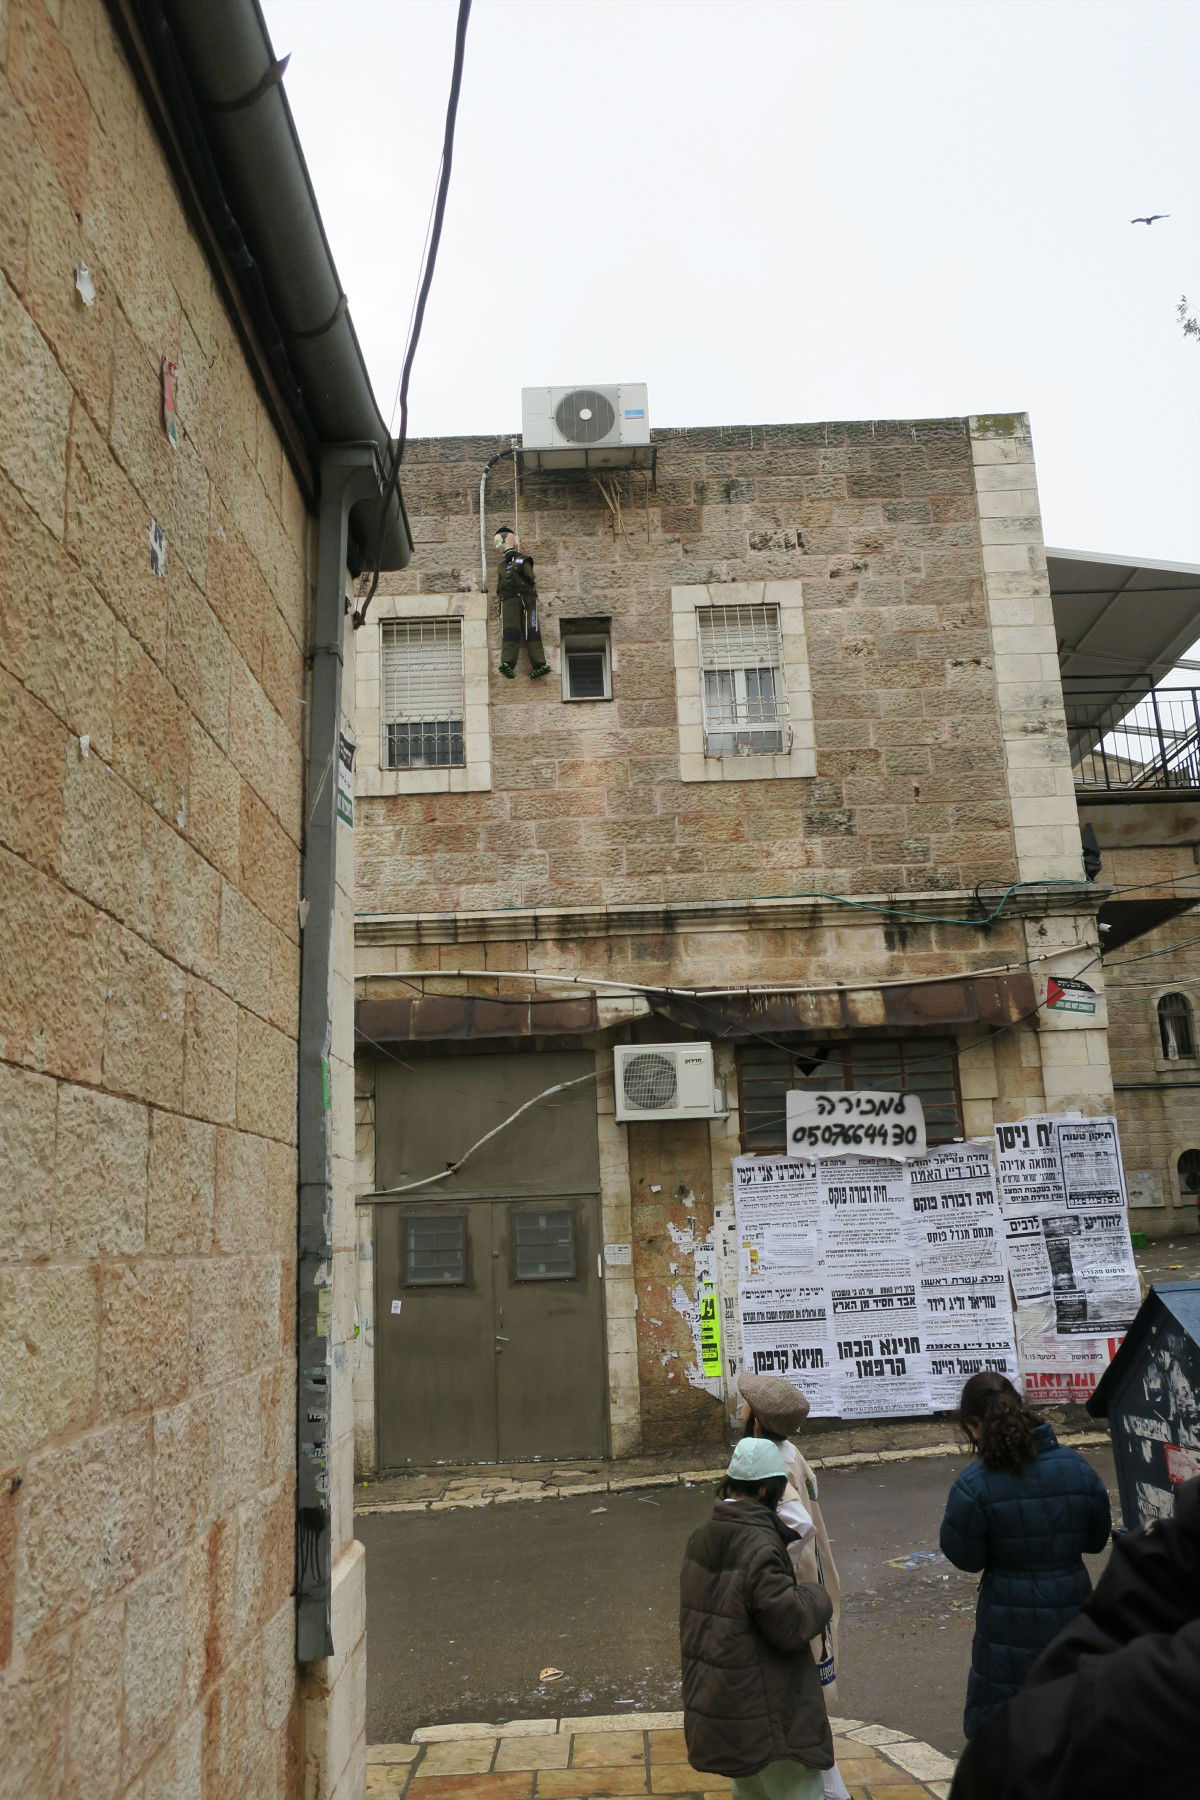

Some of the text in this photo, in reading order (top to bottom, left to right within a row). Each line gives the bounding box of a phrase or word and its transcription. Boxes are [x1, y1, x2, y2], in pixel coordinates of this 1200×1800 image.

[816, 1093, 906, 1116] למכירה
[792, 1123, 918, 1147] 0507664430
[996, 1125, 1030, 1154] ניסן
[1062, 1132, 1112, 1141] תיקון טעות
[934, 1155, 964, 1165] עזריאל
[967, 1153, 989, 1162] נחלת
[1000, 1157, 1057, 1172] ומחאה אדירה
[737, 1166, 757, 1185] ועמי
[757, 1165, 774, 1182] אני
[911, 1168, 941, 1183] האמת
[946, 1166, 962, 1180] דיין
[966, 1163, 991, 1178] ברוך
[828, 1187, 847, 1210] פוקס
[848, 1186, 872, 1204] דבורה
[873, 1185, 888, 1203] חיה
[975, 1190, 994, 1206] חיה
[1011, 1194, 1030, 1202] הגיוס
[1024, 1186, 1051, 1195] בעקבות
[913, 1196, 938, 1213] פוקס
[941, 1192, 972, 1209] דבורה
[1009, 1216, 1040, 1232] לרבים
[1083, 1214, 1122, 1230] להודיע
[927, 1227, 994, 1244] מנחם מנדל פוקס
[921, 1274, 1005, 1286] נפלה עטרת ראשנו
[799, 1286, 825, 1297] ישיבת
[833, 1296, 916, 1313] אבד חסיד מן הארץ
[927, 1296, 946, 1311] לידר
[968, 1295, 996, 1310] עזריאל
[837, 1336, 921, 1360] חנינא הכהן
[926, 1341, 1010, 1350] ברוך דיין האמת
[752, 1348, 825, 1375] חנינא קרפמן
[855, 1357, 907, 1378] קרפמן
